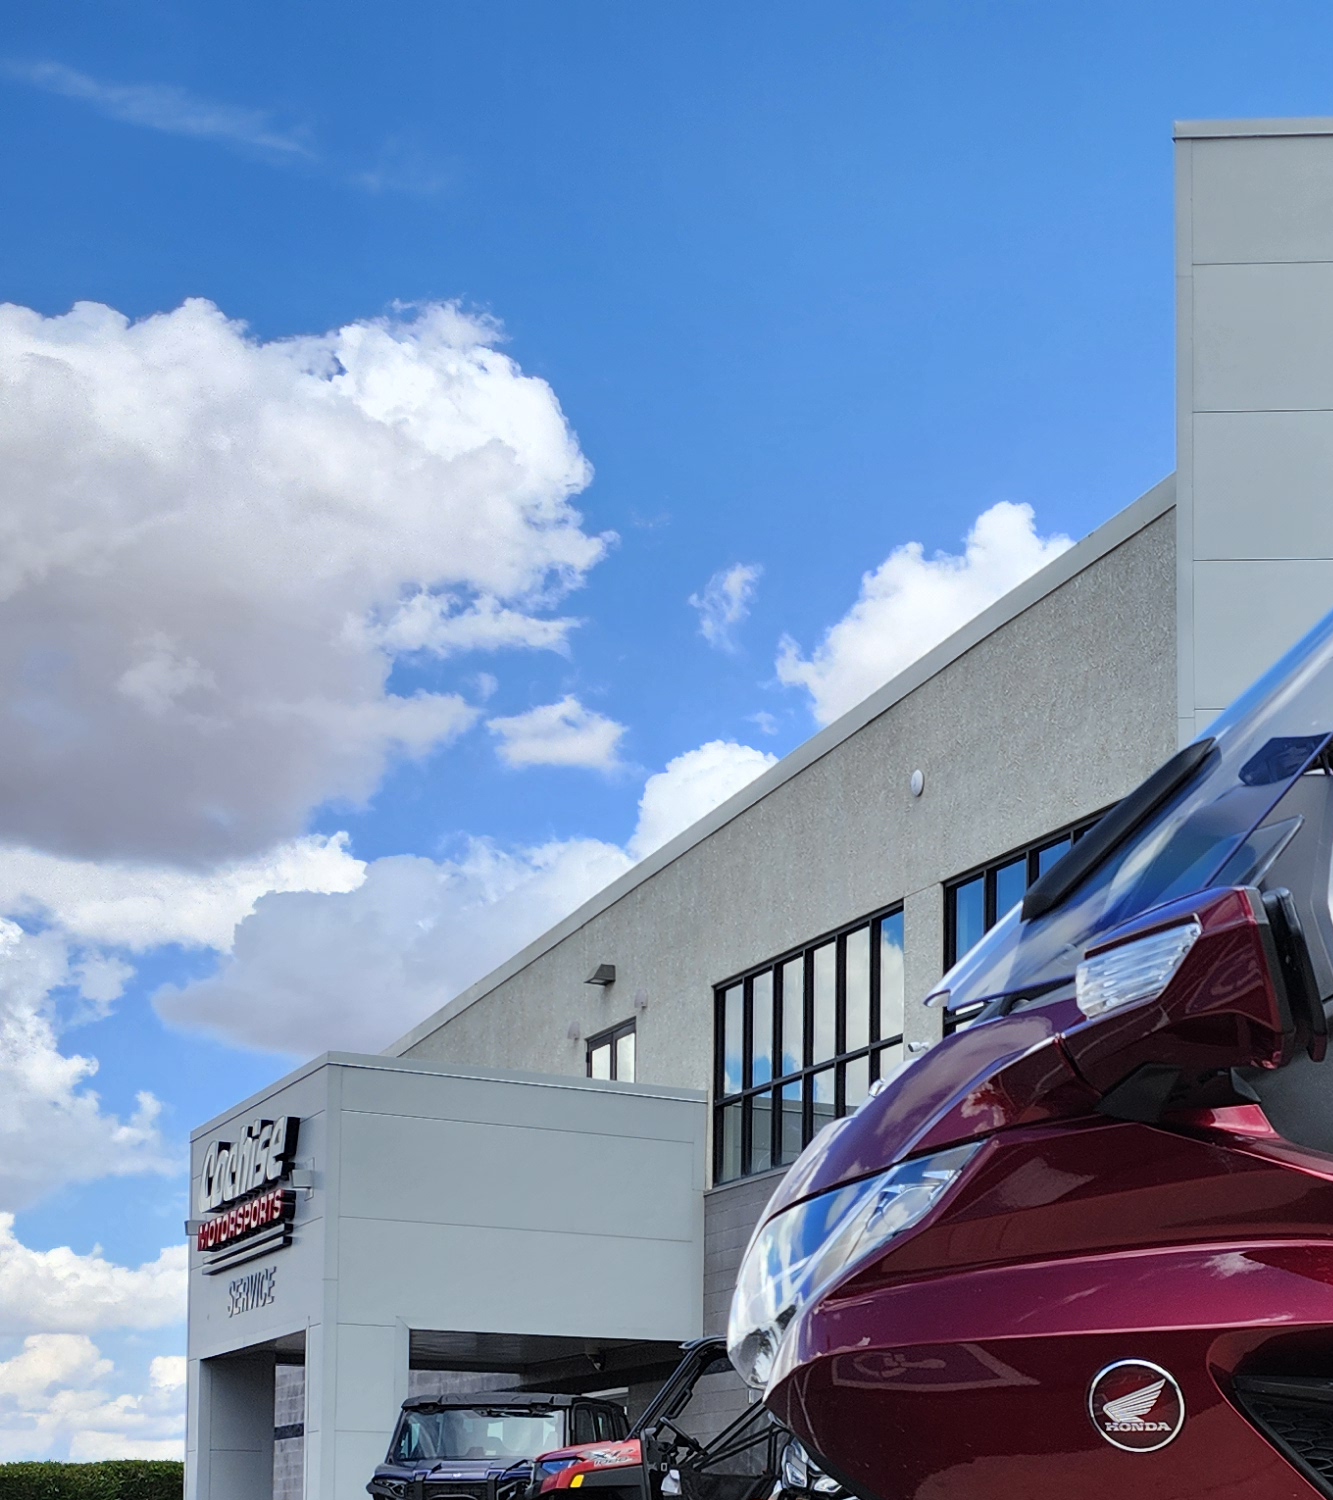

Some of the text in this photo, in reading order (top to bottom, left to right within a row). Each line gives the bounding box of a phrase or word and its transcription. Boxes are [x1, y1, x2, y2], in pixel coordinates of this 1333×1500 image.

[199, 1115, 296, 1214] Cochise
[197, 1188, 290, 1252] MOTORSPORTS
[227, 1266, 278, 1318] SERVICE
[1104, 1421, 1172, 1432] HONDA
